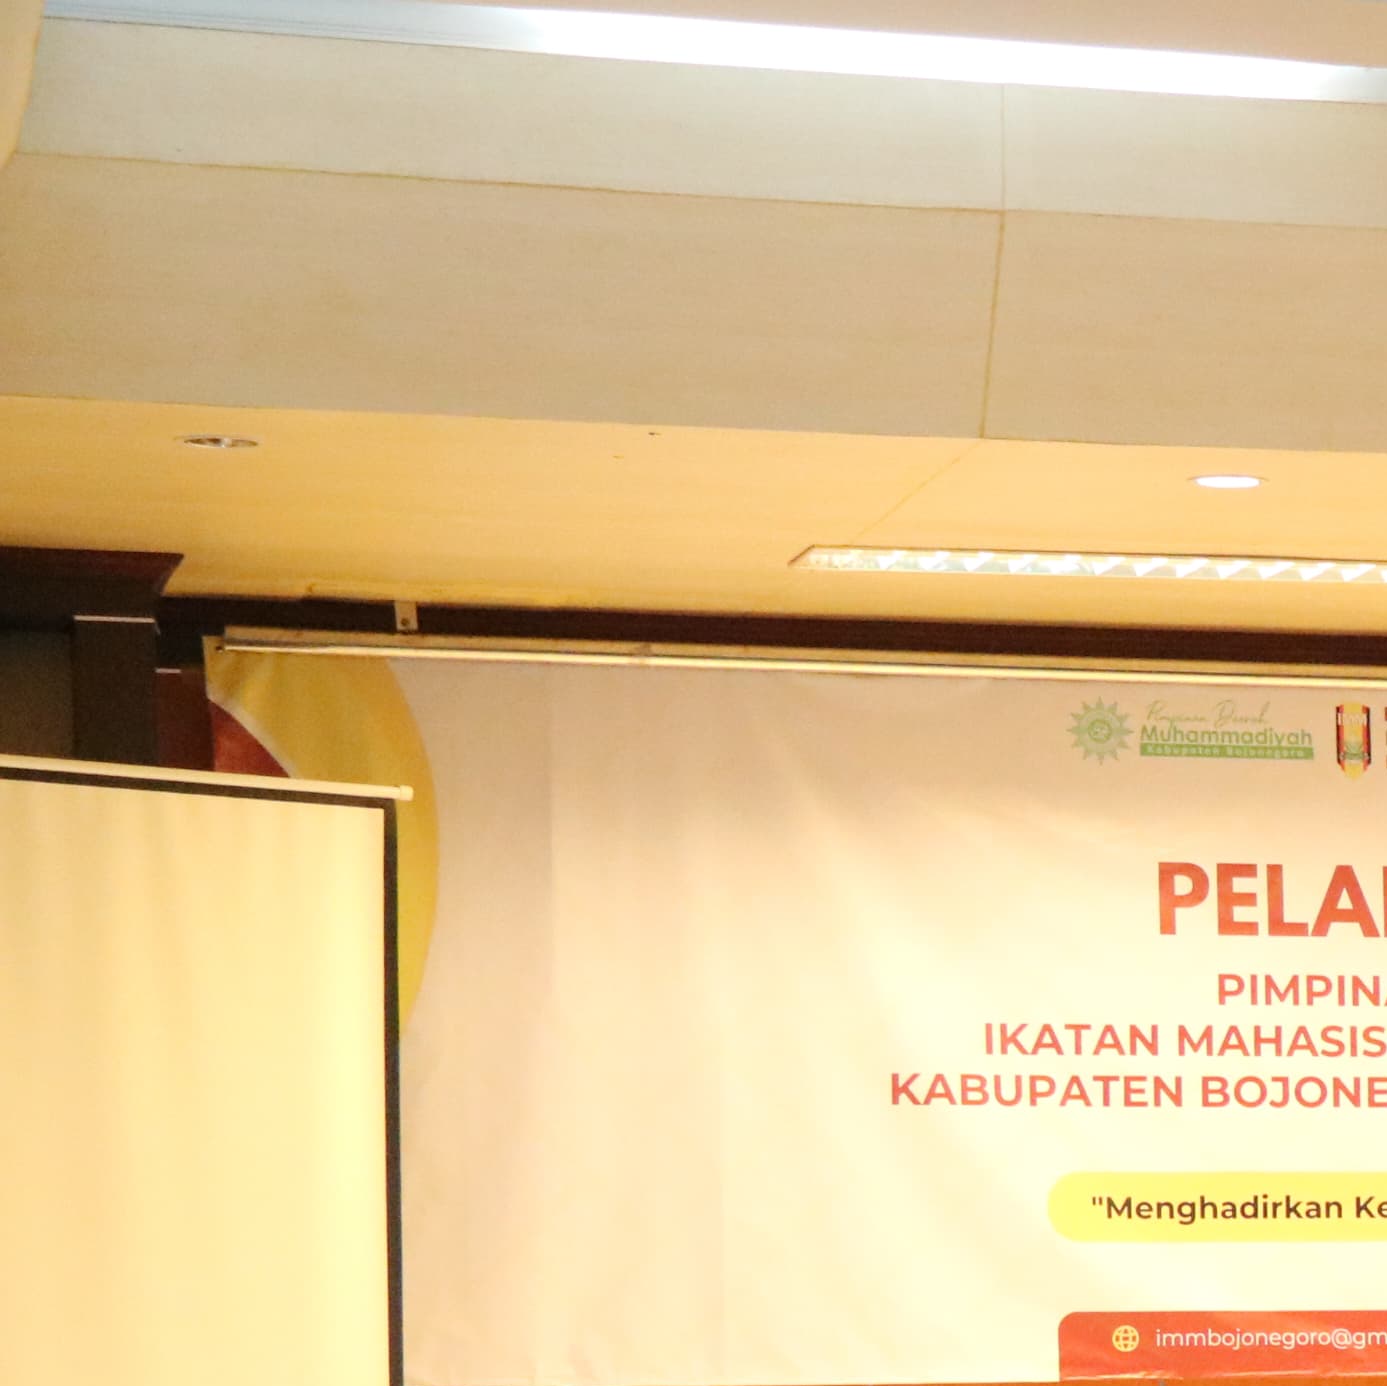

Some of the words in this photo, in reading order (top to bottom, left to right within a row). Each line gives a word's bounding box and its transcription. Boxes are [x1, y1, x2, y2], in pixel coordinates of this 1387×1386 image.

[1139, 724, 1313, 747] Muhammadiyah
[984, 1022, 1159, 1057] IKATAN
[890, 1072, 1183, 1108] KABUPATEN
[1092, 1193, 1344, 1226] "Menghadirkan
